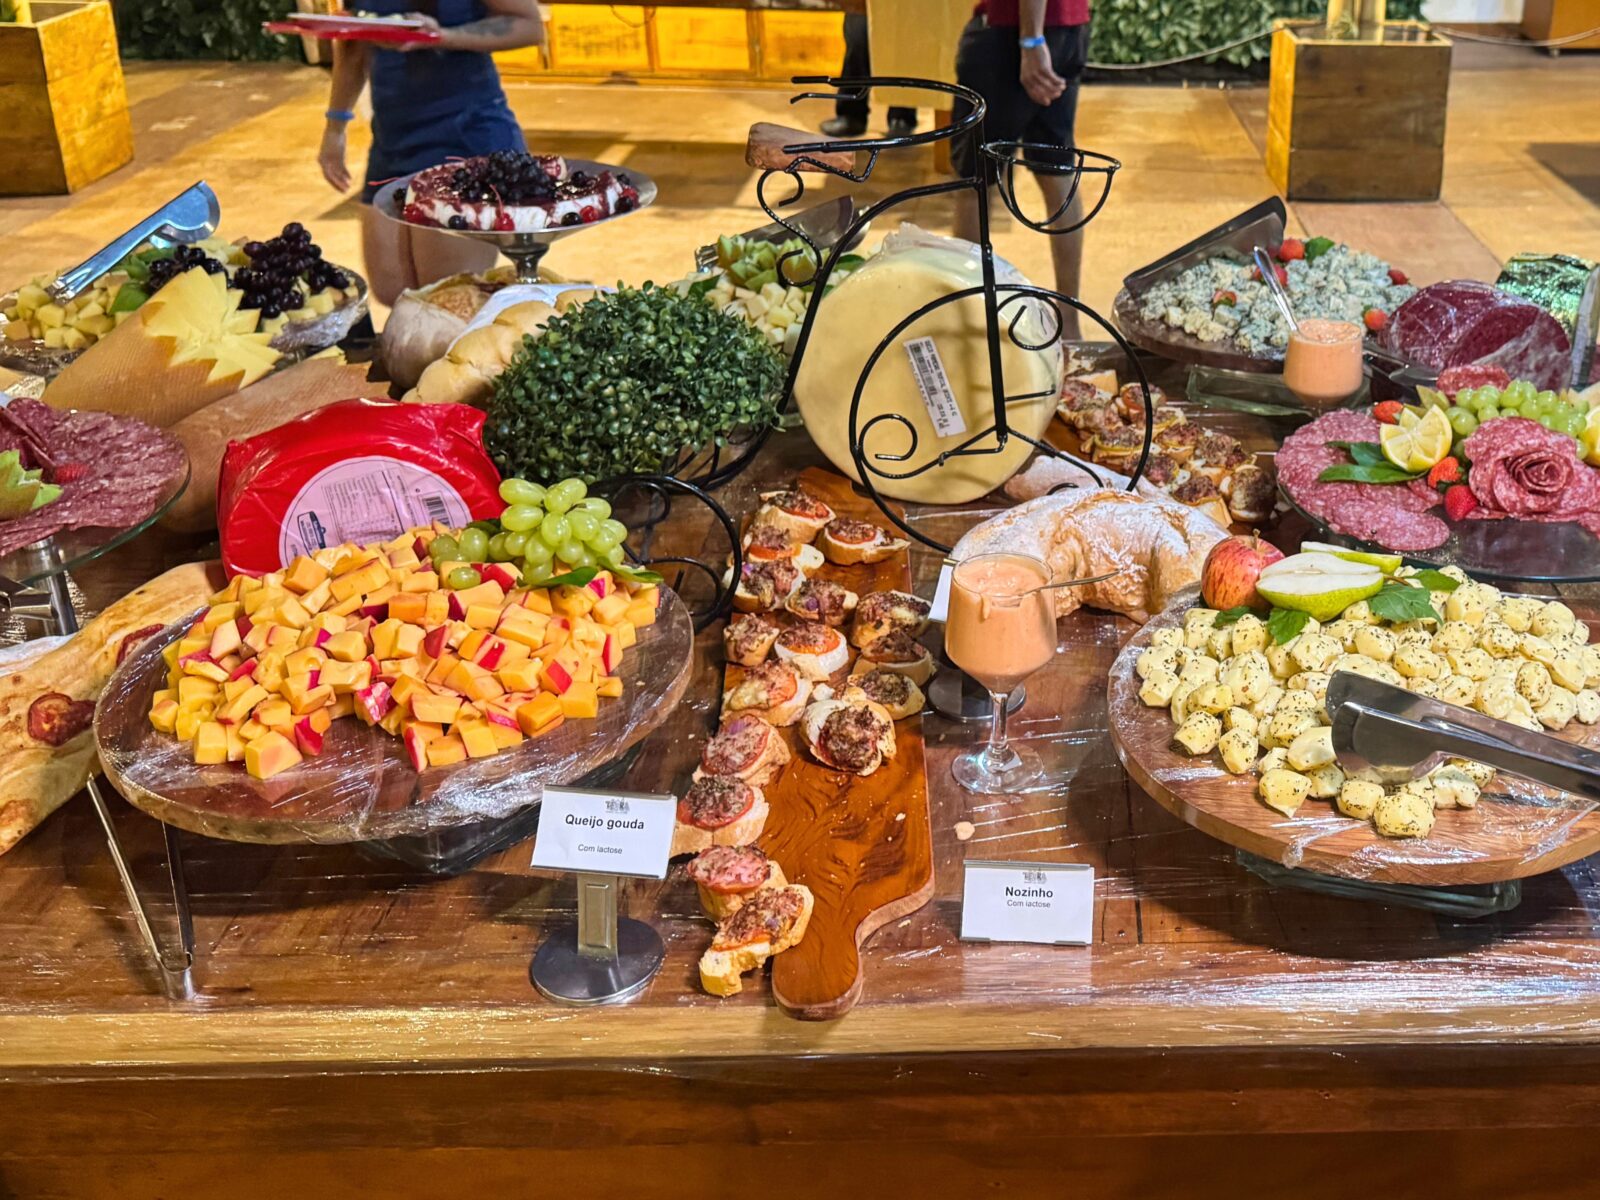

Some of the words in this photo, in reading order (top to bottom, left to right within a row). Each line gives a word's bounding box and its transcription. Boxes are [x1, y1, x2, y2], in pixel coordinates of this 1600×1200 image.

[565, 814, 604, 829] Queijo
[607, 818, 645, 830] gouda
[578, 844, 596, 852] Com
[597, 845, 623, 854] lactose
[1005, 887, 1054, 898] Nozinho
[1007, 899, 1024, 907] Com
